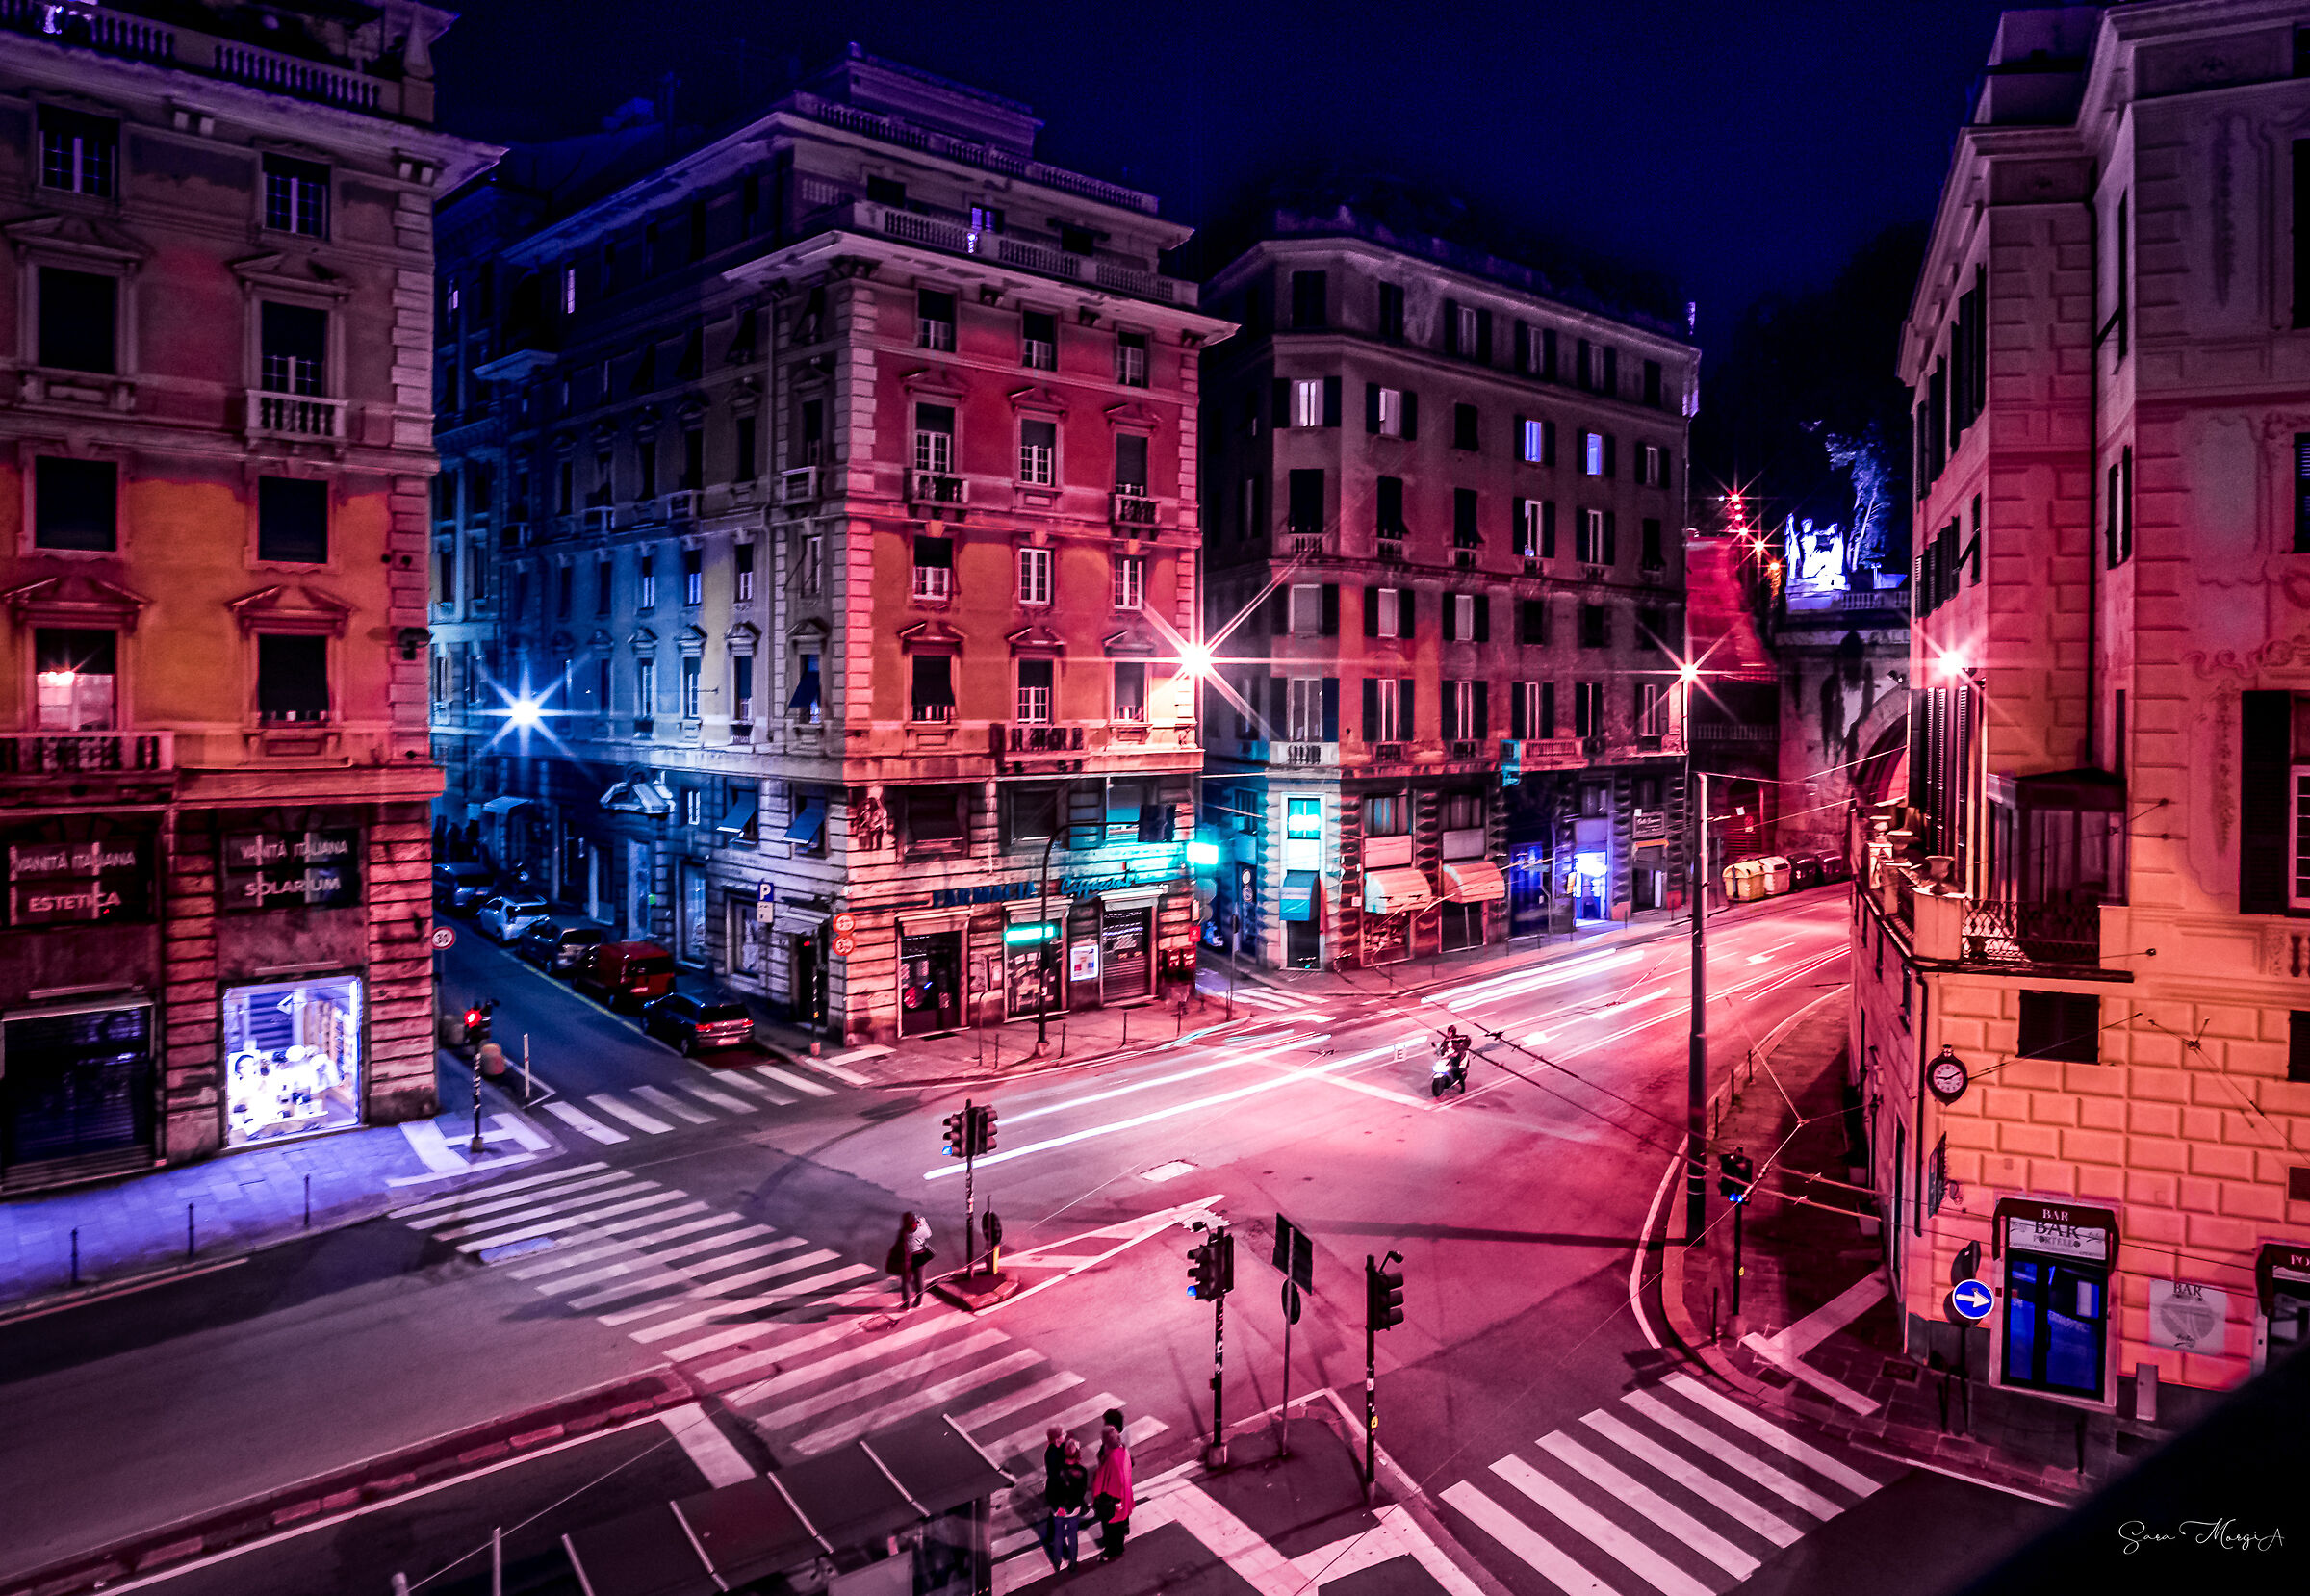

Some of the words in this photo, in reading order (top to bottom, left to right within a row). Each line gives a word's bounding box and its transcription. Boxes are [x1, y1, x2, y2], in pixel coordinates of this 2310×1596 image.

[759, 883, 772, 901] P
[2042, 1208, 2069, 1222] BAR
[2035, 1220, 2079, 1240] BAR
[2033, 1234, 2081, 1248] PRTELL
[2172, 1282, 2203, 1298] BAR
